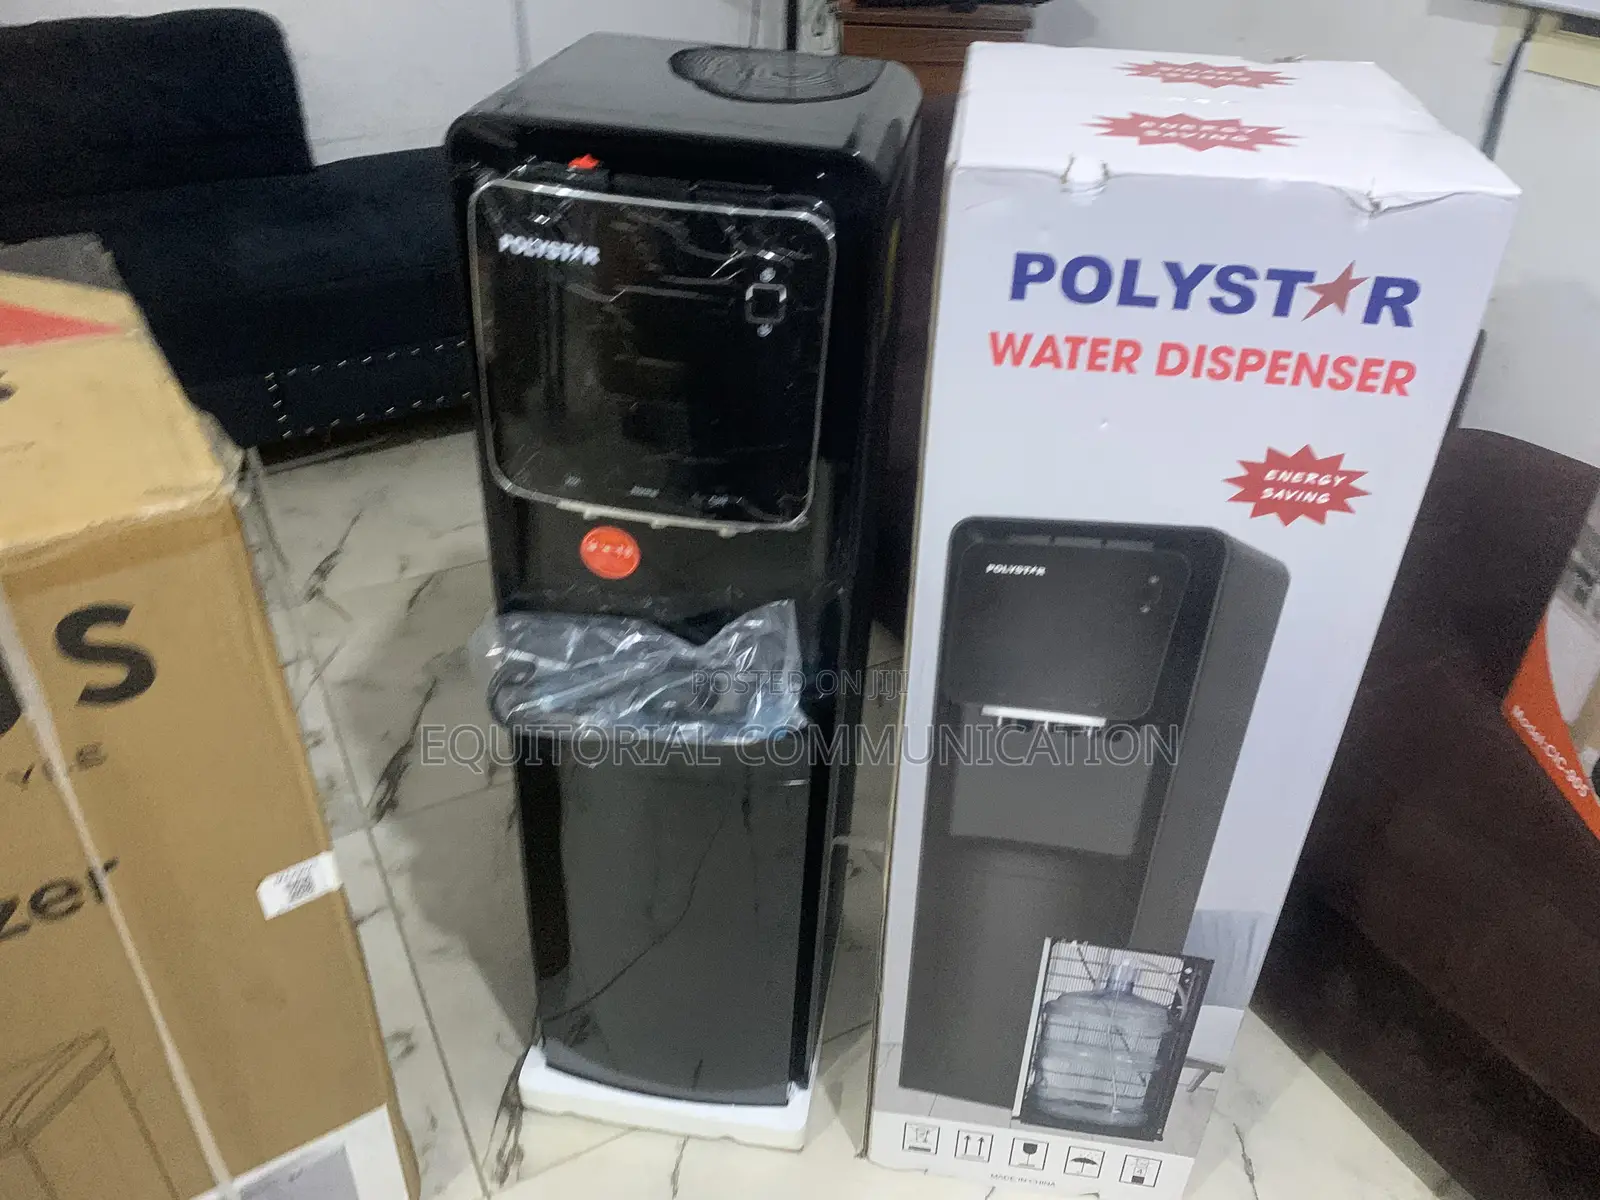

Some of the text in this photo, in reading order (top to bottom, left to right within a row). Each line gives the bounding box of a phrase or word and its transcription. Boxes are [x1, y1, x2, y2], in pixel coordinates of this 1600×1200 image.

[988, 330, 1418, 397] WATER DISPENSER
[1263, 469, 1348, 488] ENERGY
[1260, 487, 1332, 505] SAVING
[989, 1173, 1015, 1182] MADE
